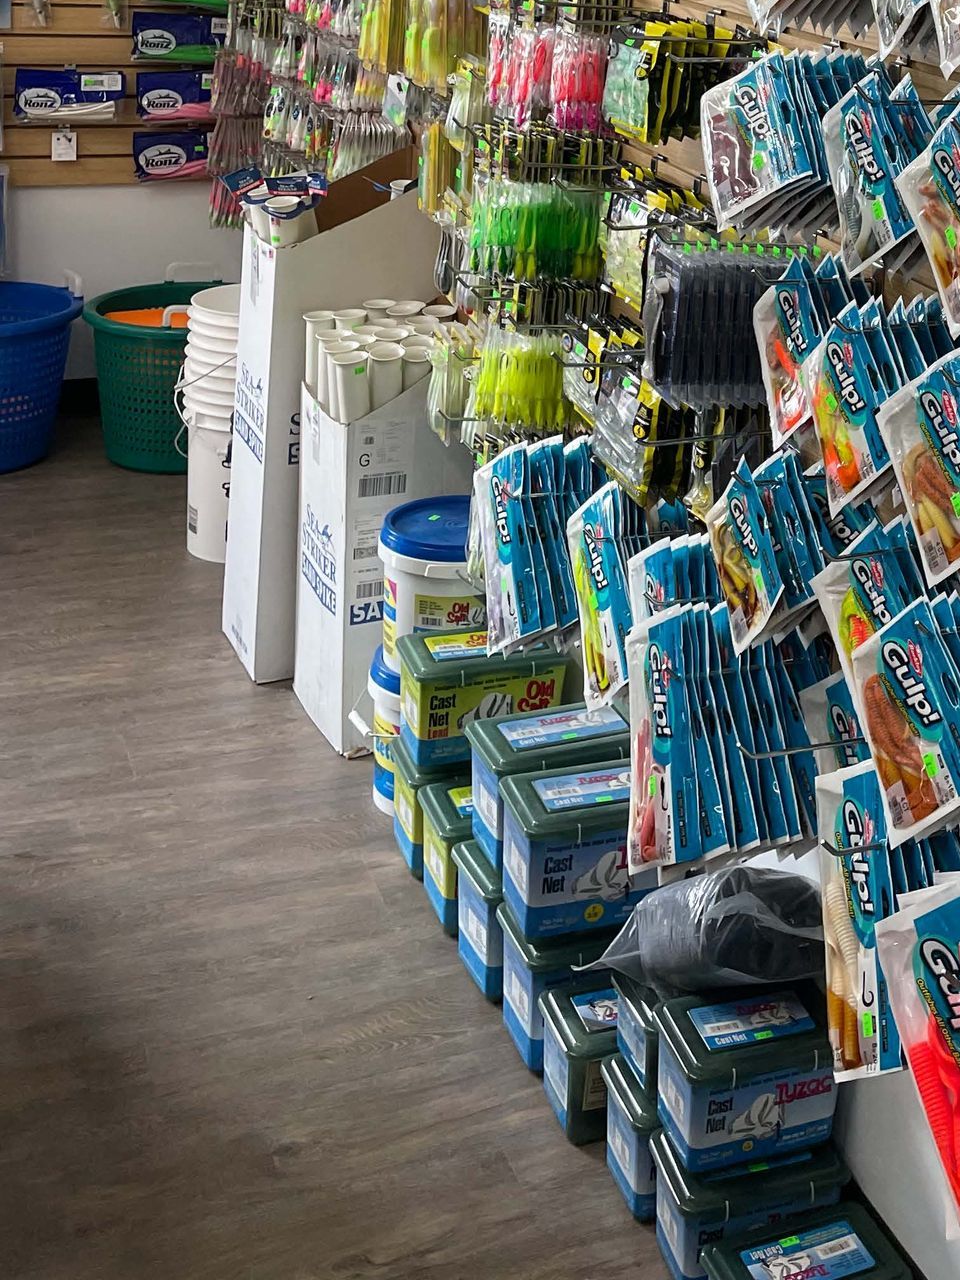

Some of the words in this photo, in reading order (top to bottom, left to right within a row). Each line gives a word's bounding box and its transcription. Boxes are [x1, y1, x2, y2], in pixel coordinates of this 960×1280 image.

[736, 86, 771, 145] Gulp!
[846, 114, 884, 182] Gulp!
[778, 291, 807, 352] Gulp!
[828, 341, 866, 414] Gulp!
[236, 380, 265, 432] STRIKER
[359, 454, 370, 467] G
[491, 475, 510, 544] Gulp!
[730, 497, 759, 556] Gulp!
[302, 523, 337, 586] STRIKER
[452, 602, 470, 615] Old
[430, 694, 457, 711] Cast
[526, 678, 556, 701] Old
[648, 643, 672, 738] Gulp!
[882, 641, 941, 726] Gulp!
[427, 727, 449, 740] Lead
[428, 711, 449, 728] Net
[541, 876, 565, 895] Net
[543, 856, 573, 875] Cast
[916, 978, 939, 1015] Outfishes
[935, 1013, 945, 1028] All
[941, 1024, 957, 1051] Other
[707, 1099, 733, 1117] Cast
[774, 1074, 833, 1106] Tyzac
[705, 1116, 726, 1134] Net
